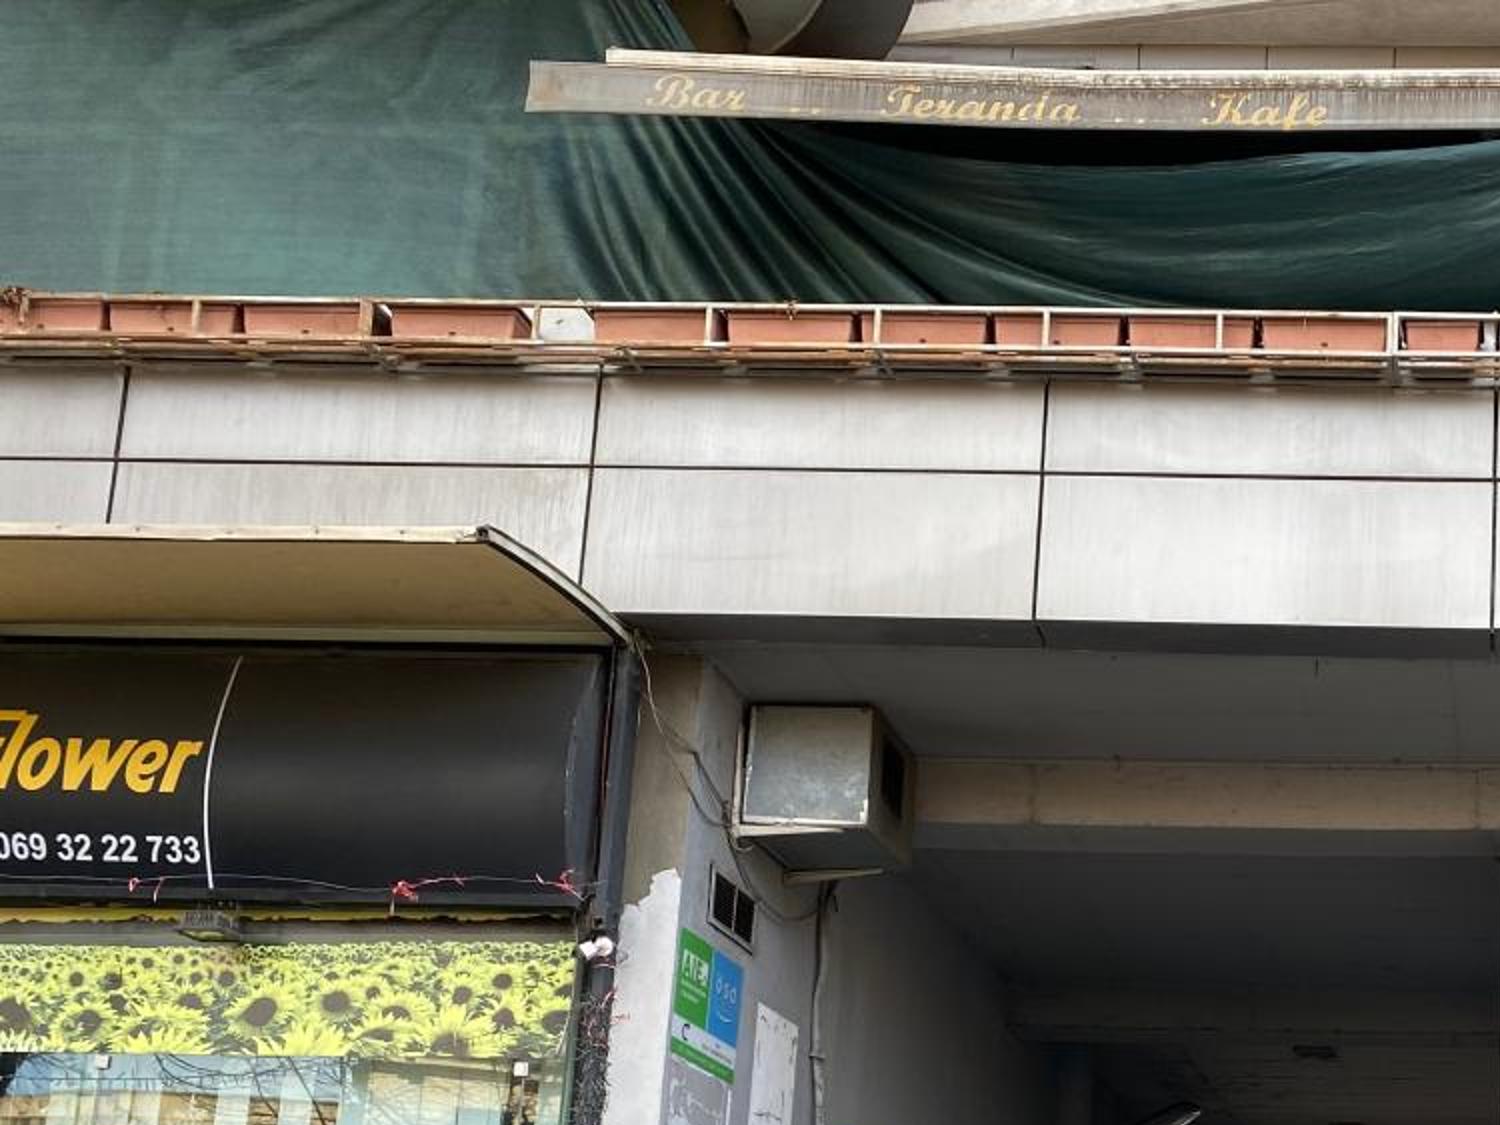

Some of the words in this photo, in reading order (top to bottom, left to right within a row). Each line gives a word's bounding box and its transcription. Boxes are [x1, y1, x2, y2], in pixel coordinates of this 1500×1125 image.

[646, 74, 747, 112] Bar
[1201, 92, 1328, 131] Kafe
[55, 832, 93, 861] 32
[101, 834, 138, 863] 22
[146, 835, 201, 863] 733
